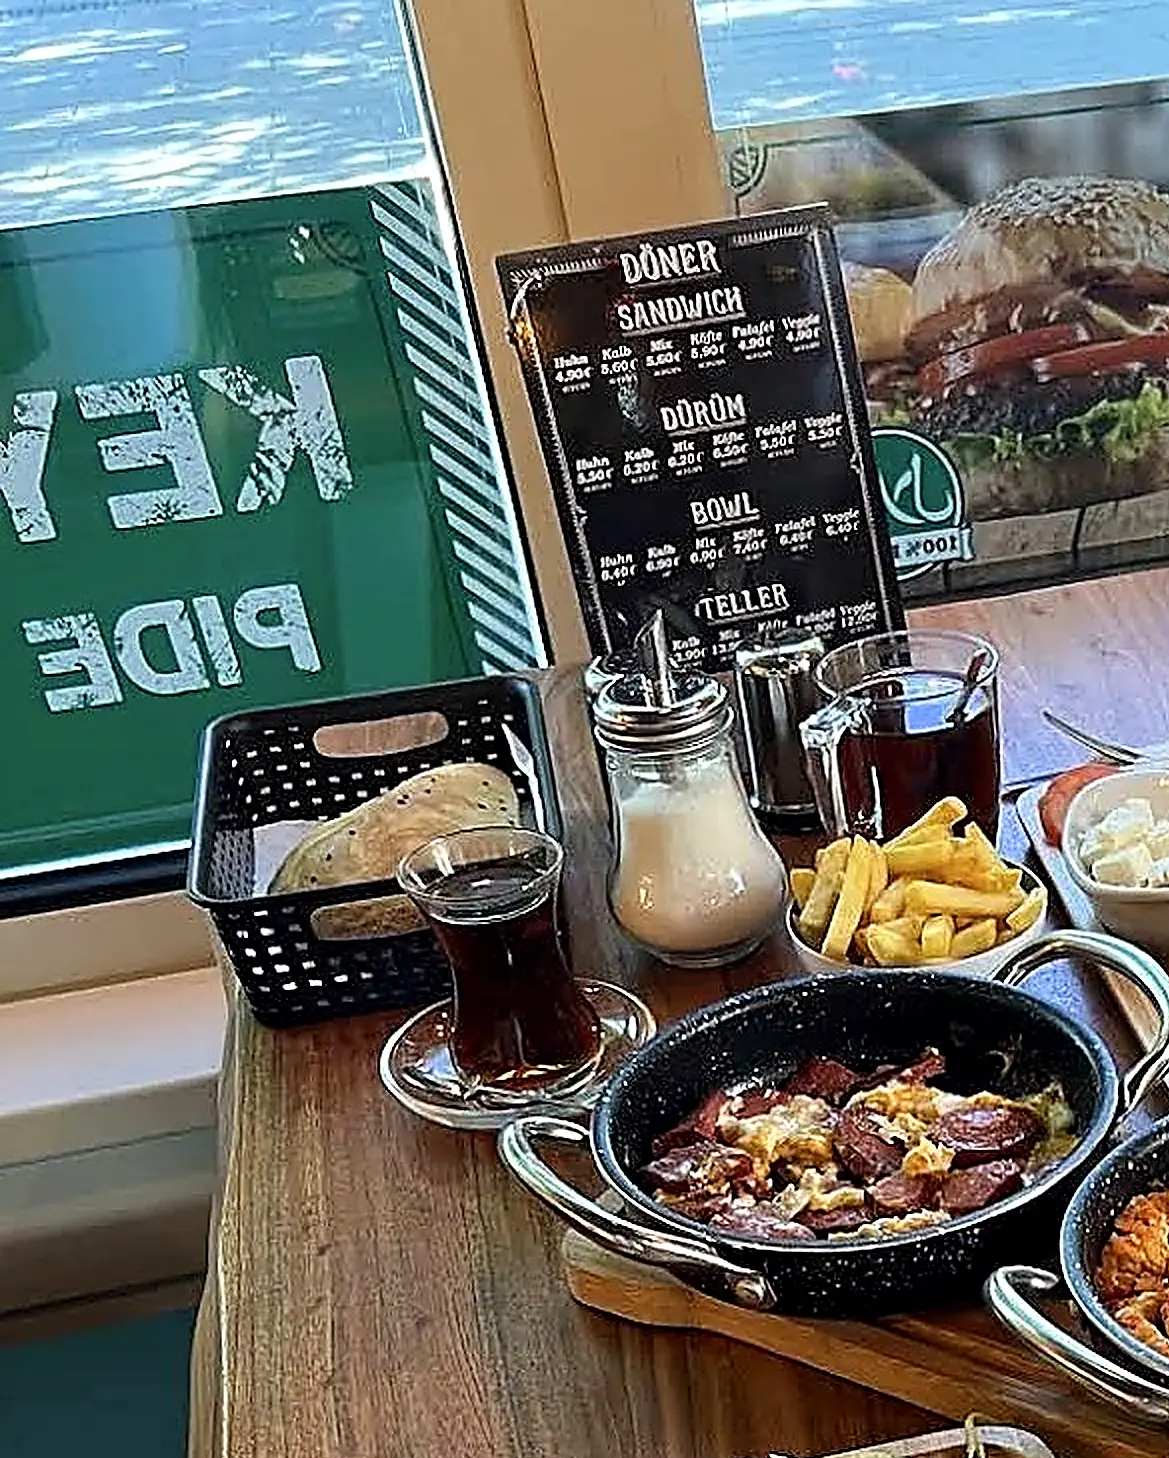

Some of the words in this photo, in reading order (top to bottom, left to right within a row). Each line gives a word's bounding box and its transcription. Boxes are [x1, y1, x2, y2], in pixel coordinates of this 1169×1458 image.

[619, 238, 721, 284] DÖNER
[617, 284, 745, 332] SANDWICH
[602, 345, 632, 361] Kalb
[659, 393, 747, 432] DÜRÜM
[690, 492, 759, 526] BOWL
[695, 583, 790, 620] TELLER
